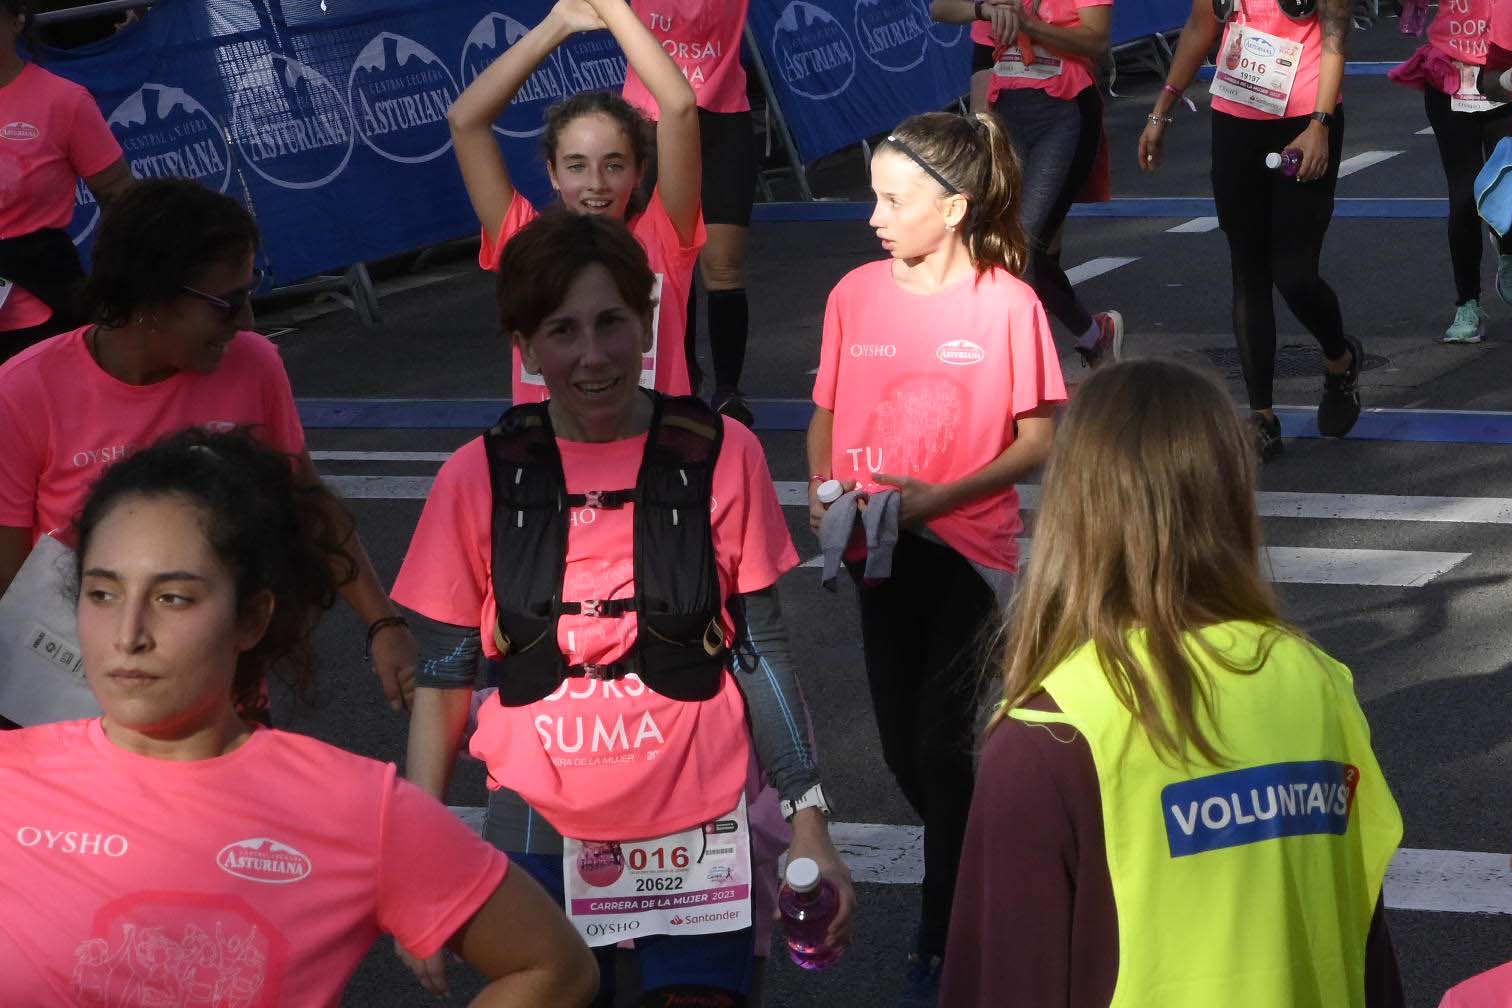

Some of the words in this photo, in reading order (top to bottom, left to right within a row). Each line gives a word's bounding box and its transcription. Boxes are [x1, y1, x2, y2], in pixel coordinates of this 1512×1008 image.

[650, 12, 671, 32] TU
[1450, 40, 1488, 55] SUM
[1241, 57, 1266, 74] 016
[850, 344, 896, 358] OYSHO
[73, 445, 130, 468] OYSH
[846, 446, 883, 473] TU
[534, 709, 665, 753] SUMA
[17, 825, 129, 859] OYSHO
[225, 852, 305, 876] ASTURIANA
[629, 847, 690, 871] 016
[636, 877, 683, 892] 20622
[590, 900, 639, 912] CARRERA
[641, 899, 655, 910] DE
[657, 897, 671, 908] LA
[673, 894, 708, 906] MUJER
[712, 890, 736, 902] 2023
[685, 910, 741, 925] Santander
[586, 920, 640, 937] OYSHO
